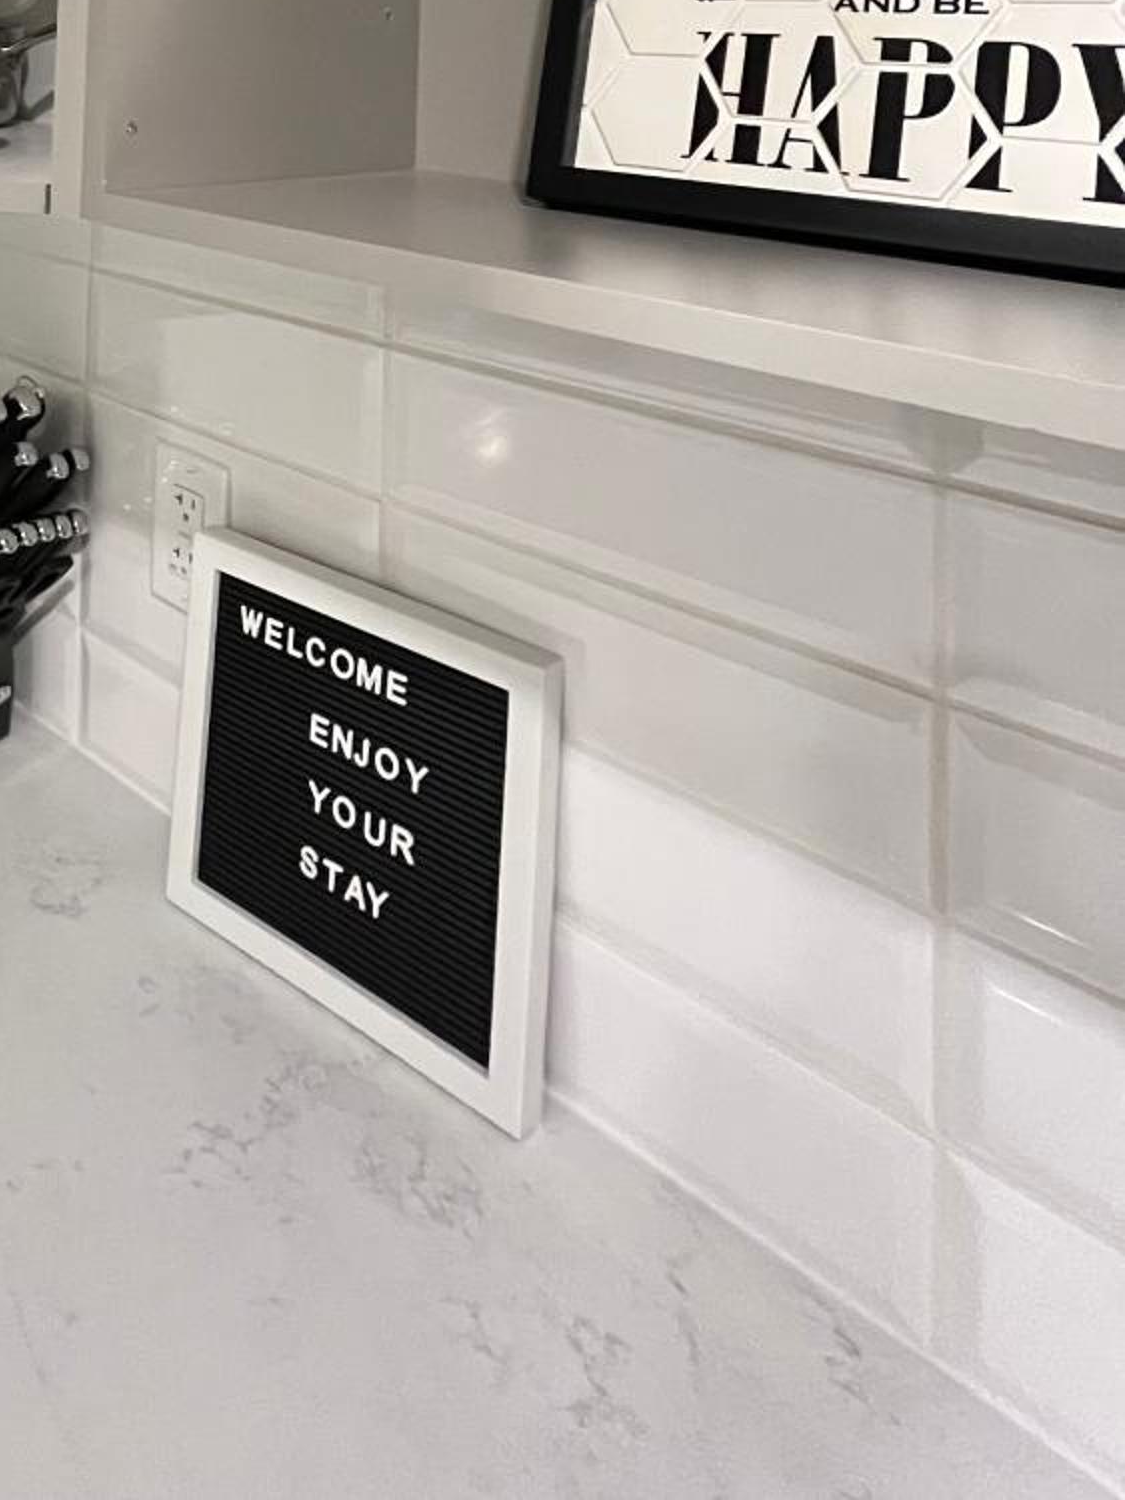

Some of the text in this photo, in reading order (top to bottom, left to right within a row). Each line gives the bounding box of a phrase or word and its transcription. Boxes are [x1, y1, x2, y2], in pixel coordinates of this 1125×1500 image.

[239, 604, 410, 707] WELCOME
[308, 712, 431, 795] ENJOY
[307, 779, 417, 866] YOUR
[298, 845, 392, 920] STAY
